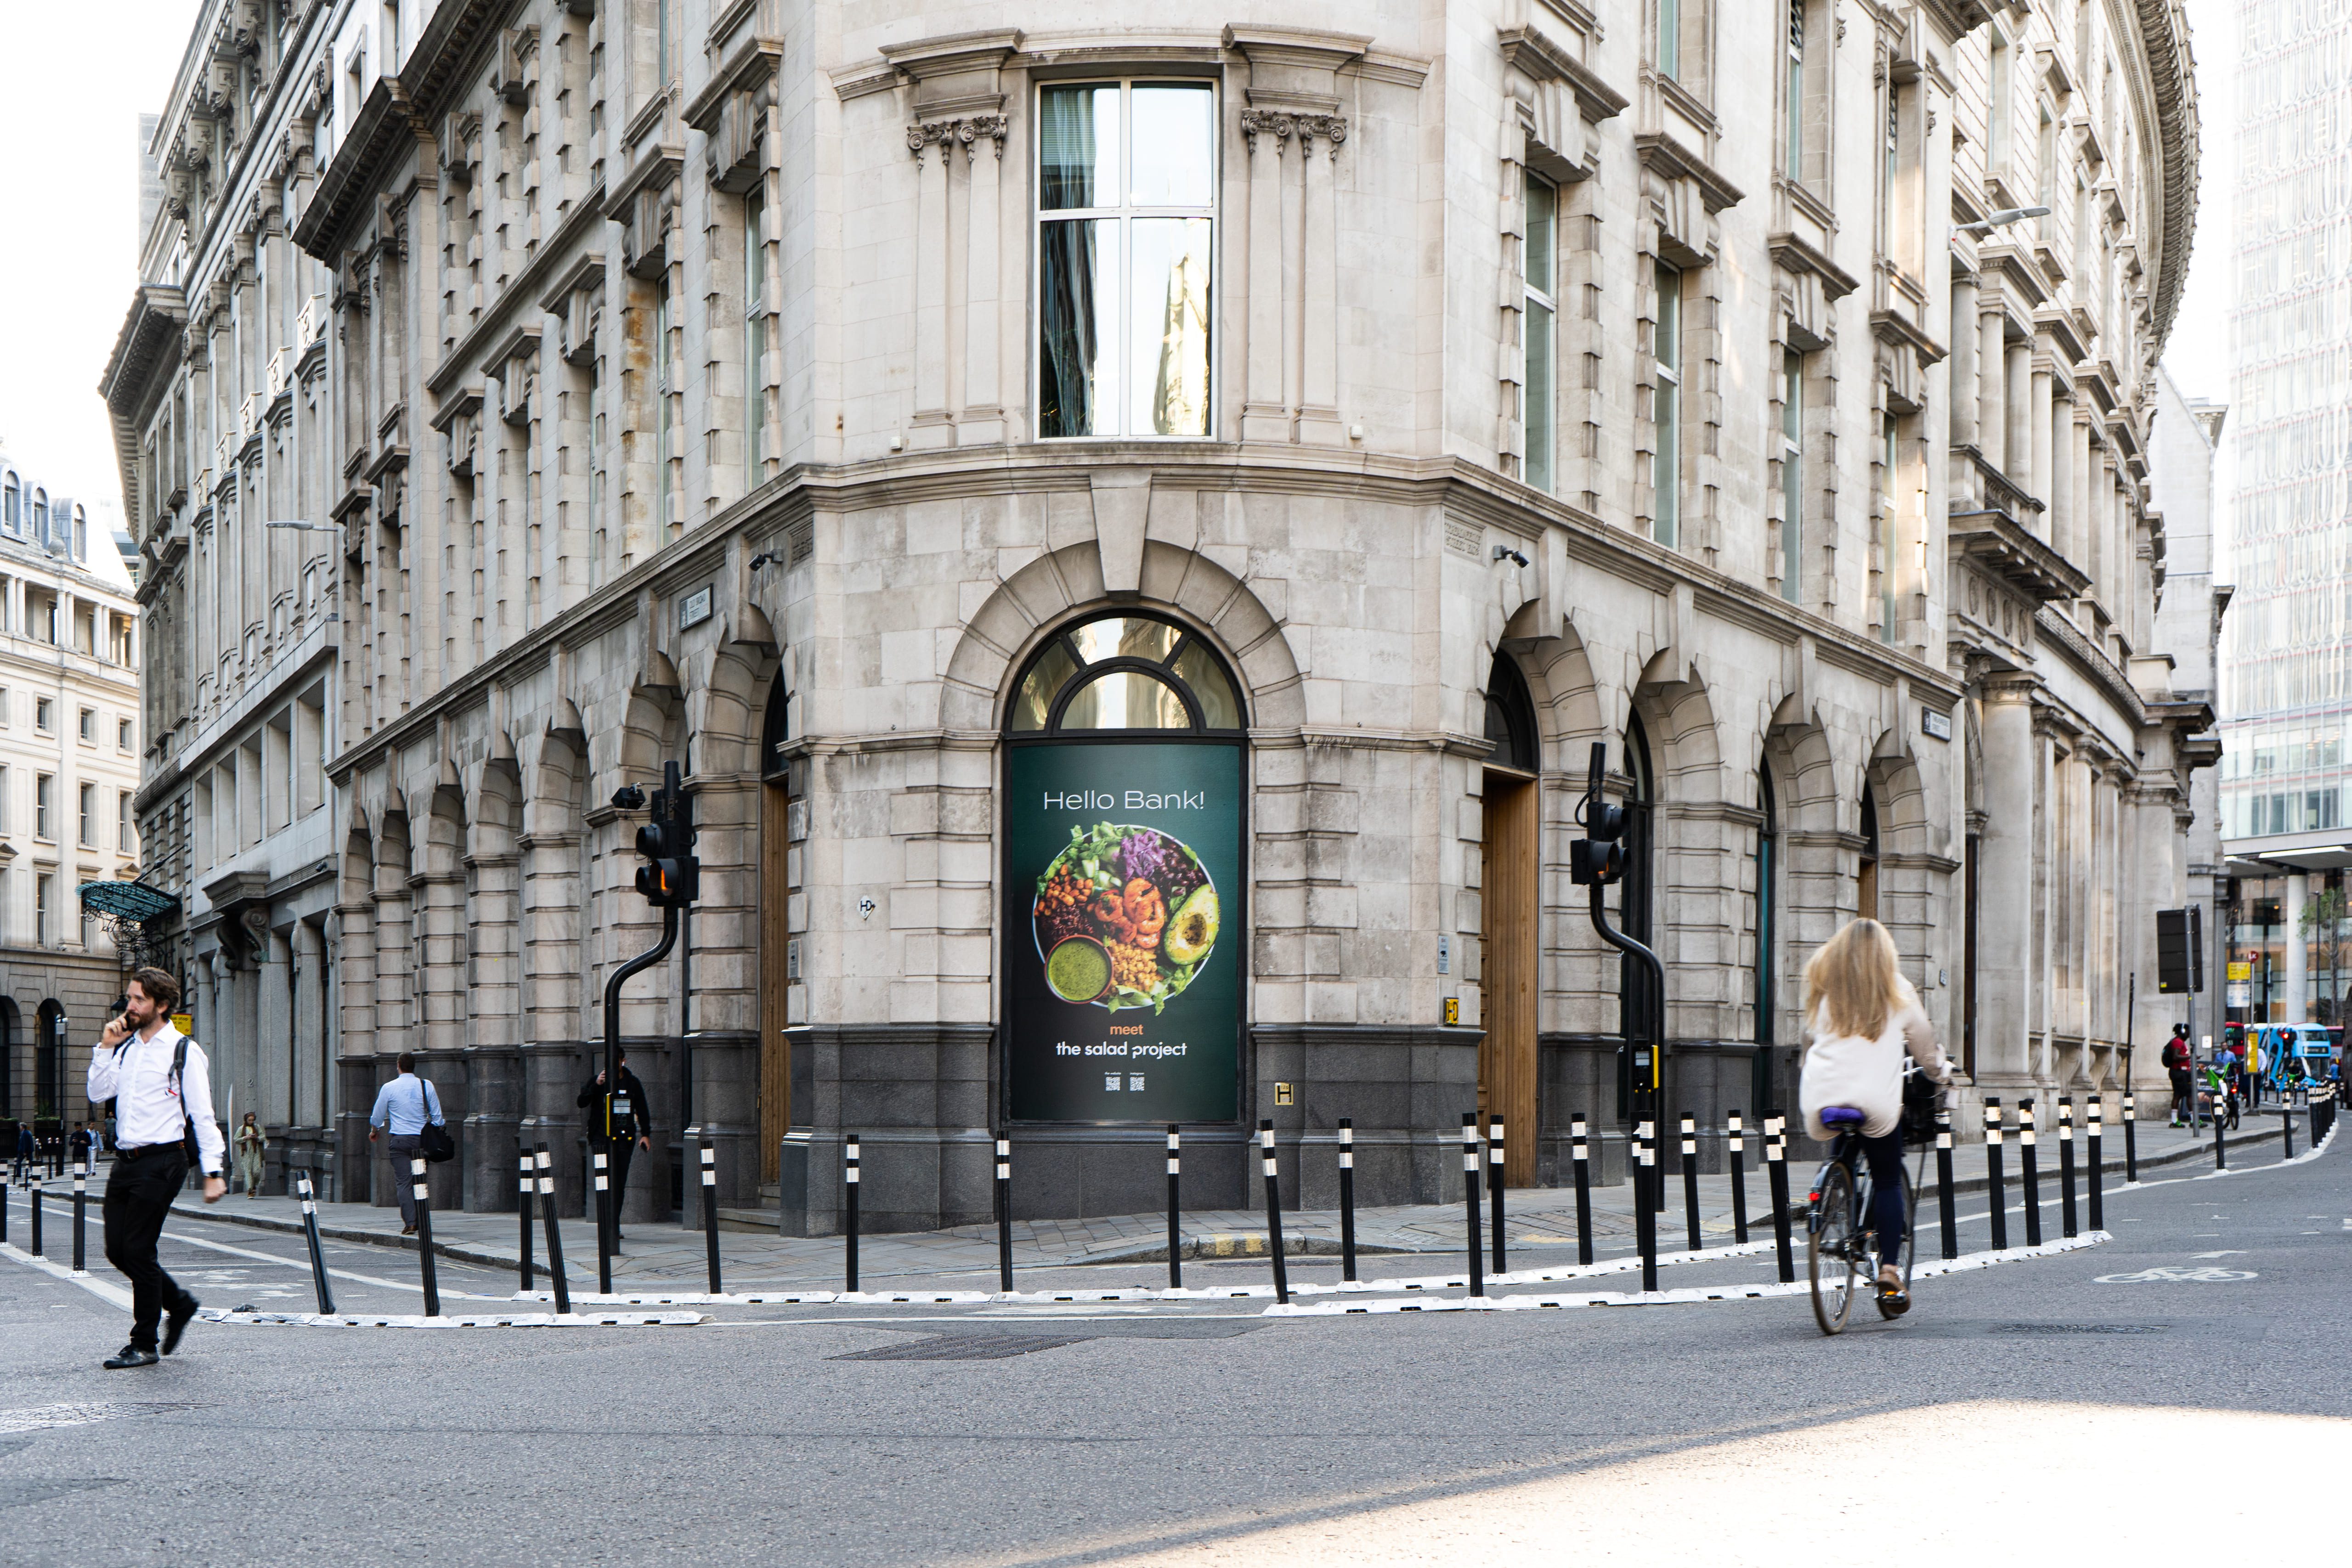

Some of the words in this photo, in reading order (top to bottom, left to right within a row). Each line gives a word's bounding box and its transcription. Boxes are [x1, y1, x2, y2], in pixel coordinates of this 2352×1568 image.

[1044, 790, 1115, 810] Hello
[1124, 790, 1204, 810] Bank!
[860, 900, 872, 911] HD
[1110, 1024, 1143, 1035] meet
[1056, 1041, 1081, 1055] the
[1084, 1041, 1128, 1056] salad
[1131, 1041, 1187, 1060] project
[247, 1078, 254, 1088] 2
